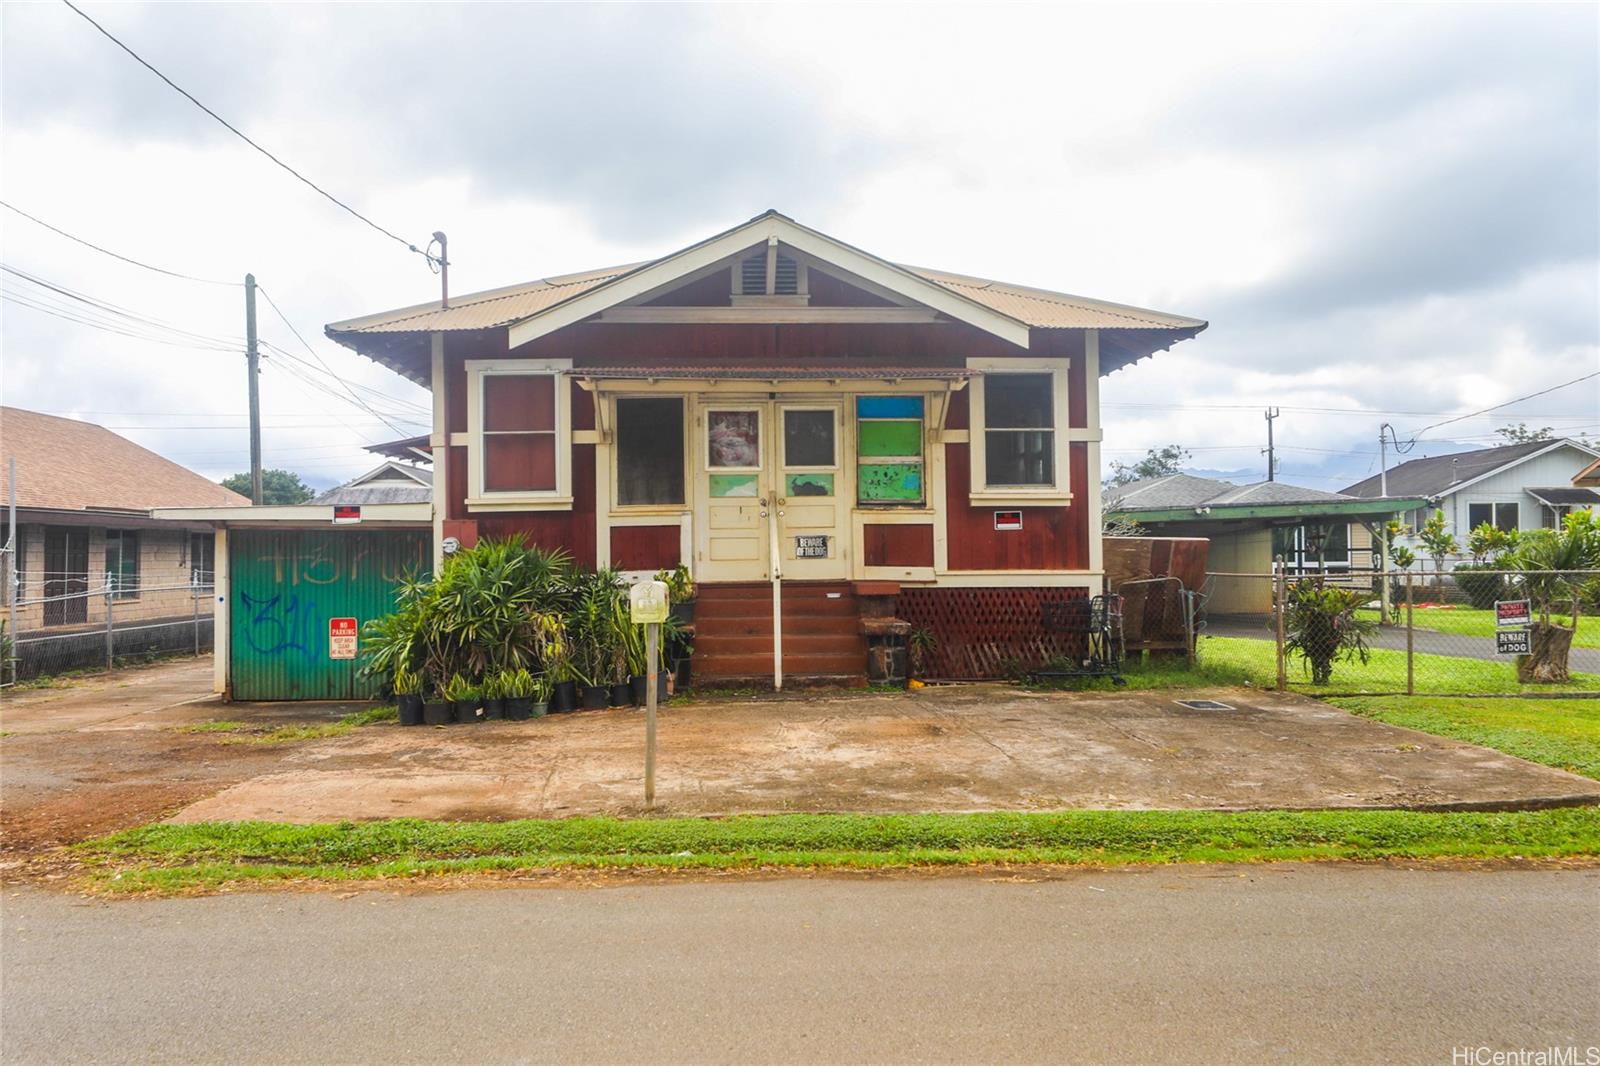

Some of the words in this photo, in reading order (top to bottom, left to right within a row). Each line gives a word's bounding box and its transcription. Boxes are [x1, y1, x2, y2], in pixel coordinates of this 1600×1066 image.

[800, 537, 824, 547] BEWARE
[1500, 633, 1526, 641] BEWARE
[1508, 643, 1527, 651] DOG
